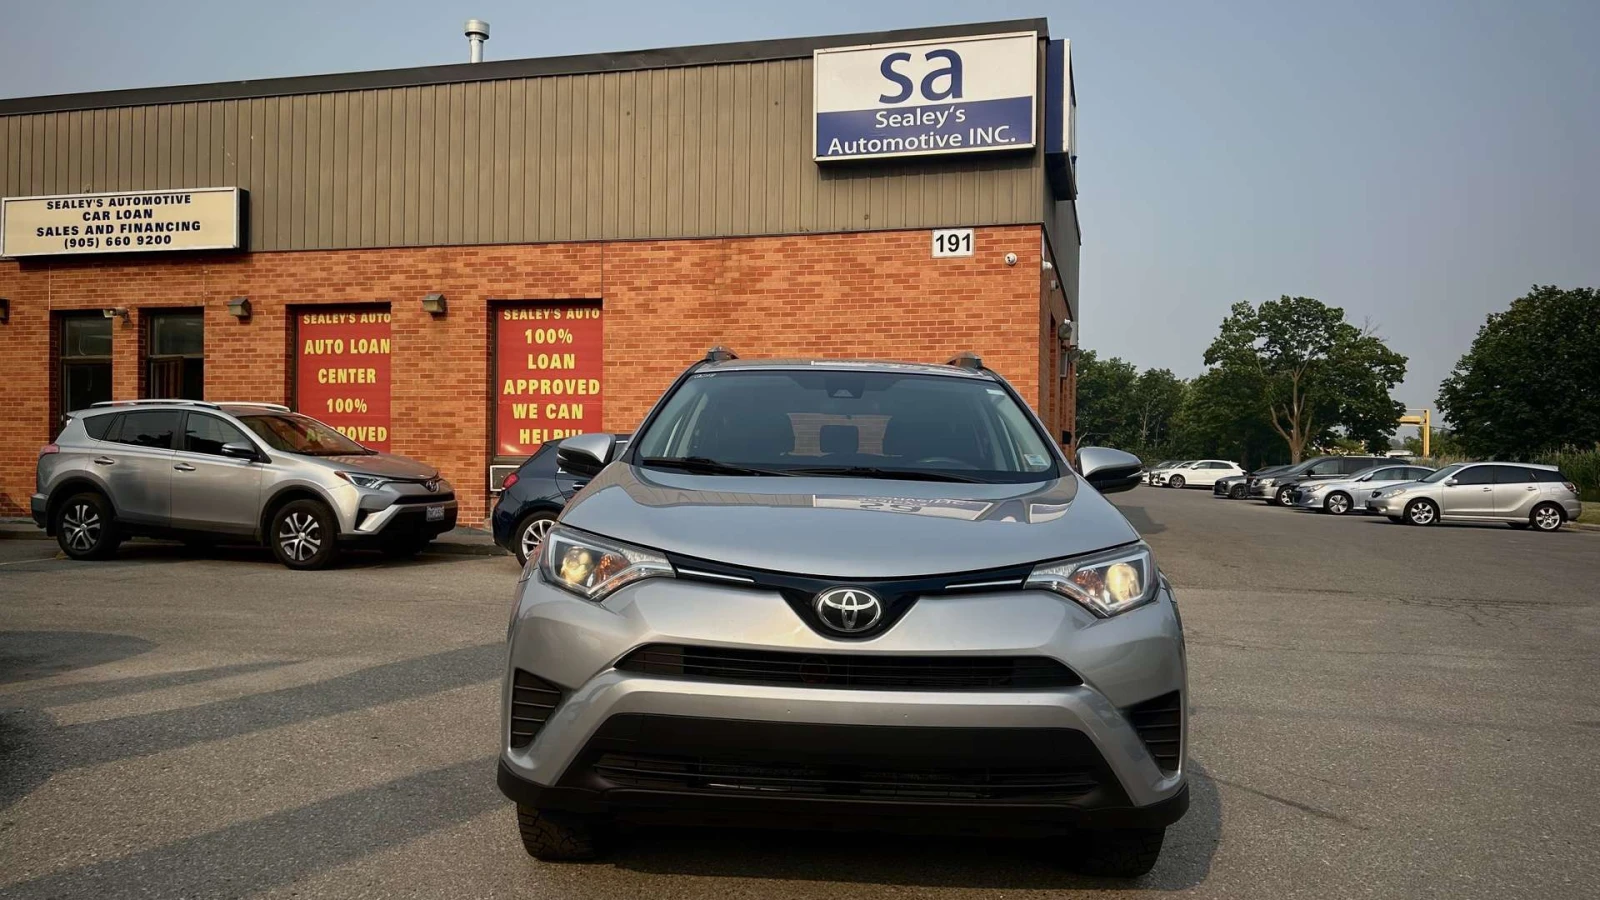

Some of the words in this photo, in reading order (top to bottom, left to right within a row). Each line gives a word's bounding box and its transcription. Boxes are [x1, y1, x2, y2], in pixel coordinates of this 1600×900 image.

[878, 48, 963, 104] sa
[875, 106, 966, 129] Sealey's
[828, 131, 962, 155] Automotive
[969, 126, 1016, 145] INC.
[46, 198, 104, 210] SEALEY'S
[108, 194, 191, 208] AUTOMOTIVE
[82, 210, 110, 222] CAR
[116, 208, 153, 220] LOAN
[36, 225, 79, 237] SALES
[85, 223, 114, 235] AND
[120, 220, 201, 234] FINANCING
[64, 237, 100, 249] (905)
[105, 235, 131, 247] 660
[136, 234, 172, 246] 9200
[935, 233, 971, 253] 191
[303, 313, 356, 324] SEALEY'S
[360, 312, 391, 324] AUTO
[504, 308, 561, 320] SEALEY'S
[566, 307, 600, 319] AUTO
[525, 328, 573, 344] 100%
[304, 339, 344, 355] AUTO
[350, 338, 391, 354] LOAN
[528, 353, 575, 370] LOAN
[318, 368, 376, 384] CENTER
[503, 379, 600, 395] APPROVED
[326, 398, 367, 413] 100%
[512, 403, 538, 419] WE
[545, 403, 583, 419] CAN
